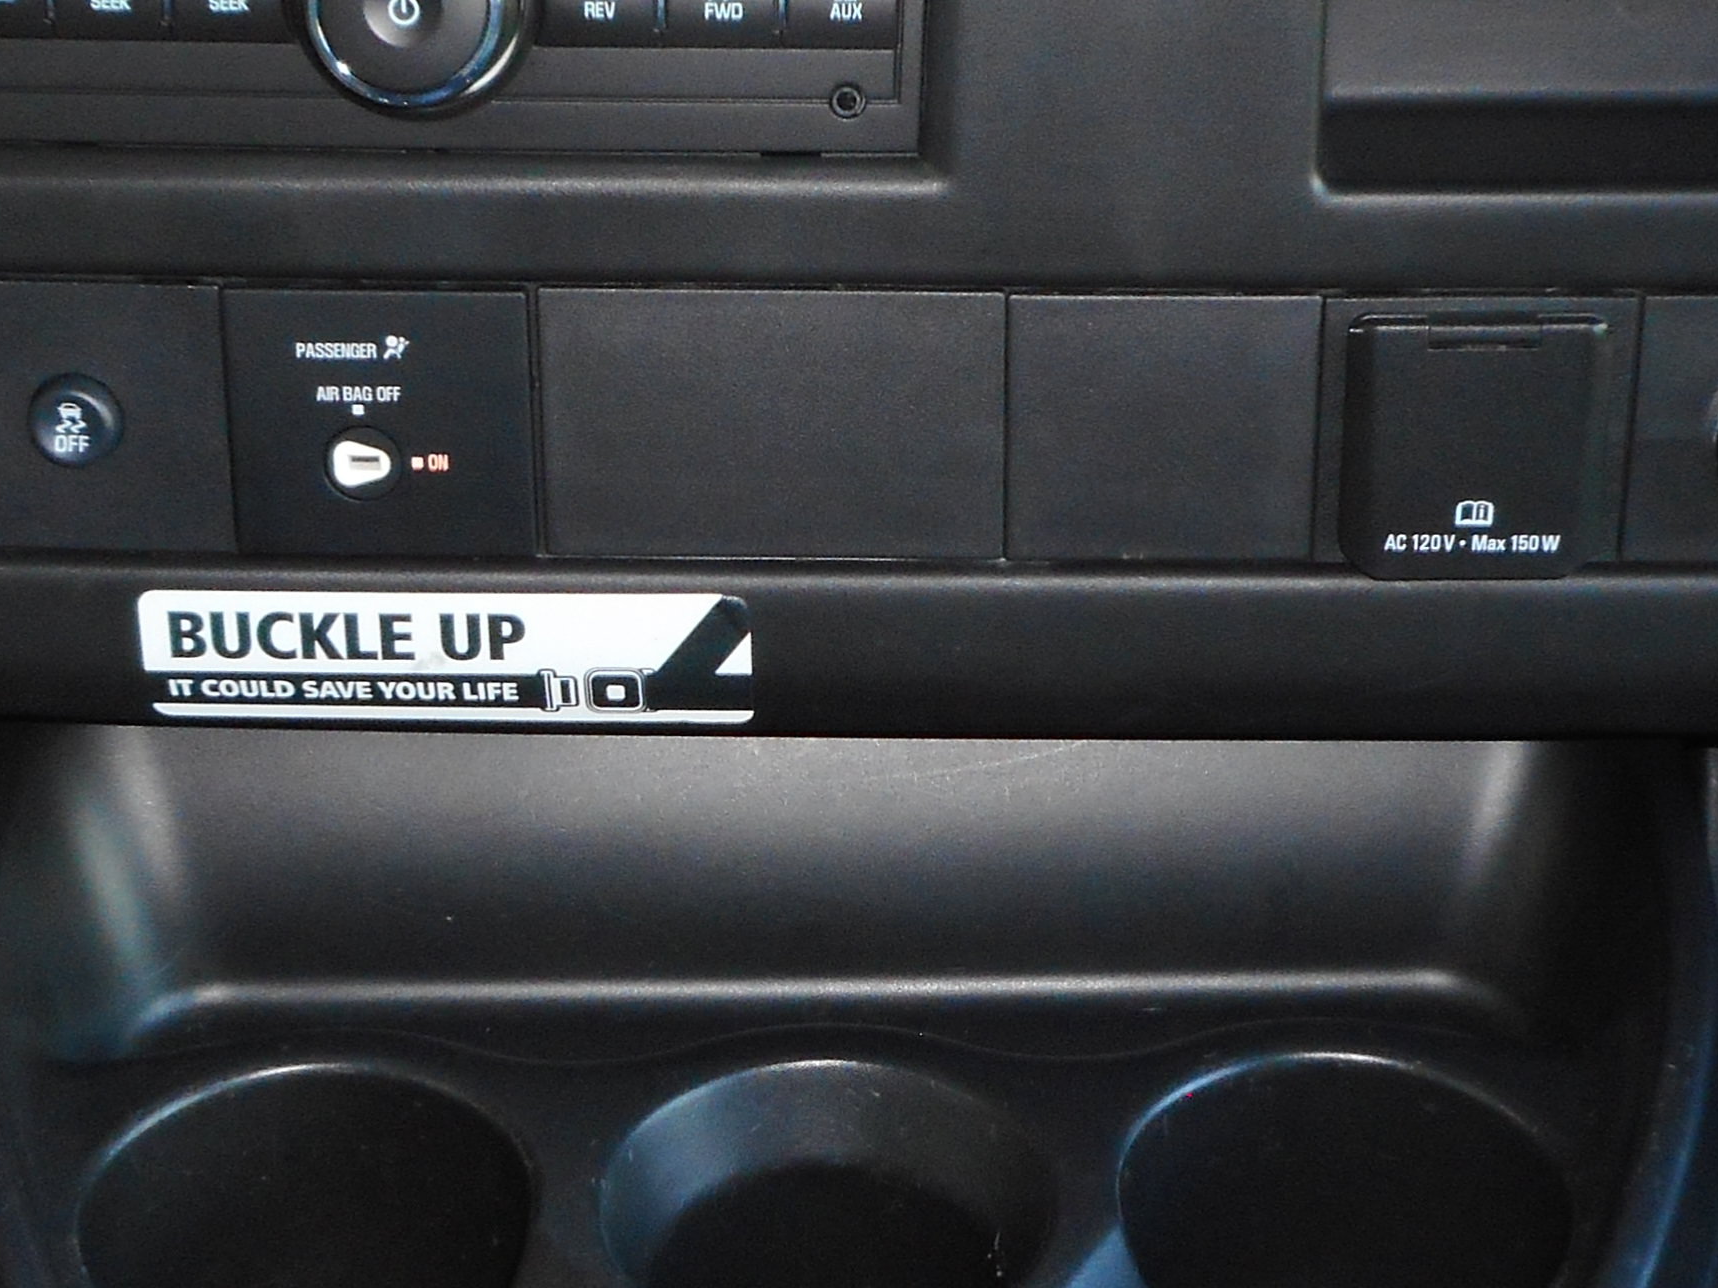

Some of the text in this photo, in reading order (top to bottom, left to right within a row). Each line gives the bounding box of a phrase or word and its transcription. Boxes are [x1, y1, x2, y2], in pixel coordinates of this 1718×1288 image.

[583, 0, 616, 20] REV
[704, 0, 744, 21] FWD
[829, 1, 863, 21] AUX
[295, 342, 378, 360] PASSENGER
[316, 385, 401, 403] AIR BAG OFF
[52, 431, 89, 455] OFF
[427, 453, 449, 472] ON
[1383, 533, 1407, 552] AC
[1471, 534, 1506, 553] Max
[167, 611, 526, 661] BUCKLE UP
[168, 677, 519, 703] IT COULD SAVE YOUR LIFE
